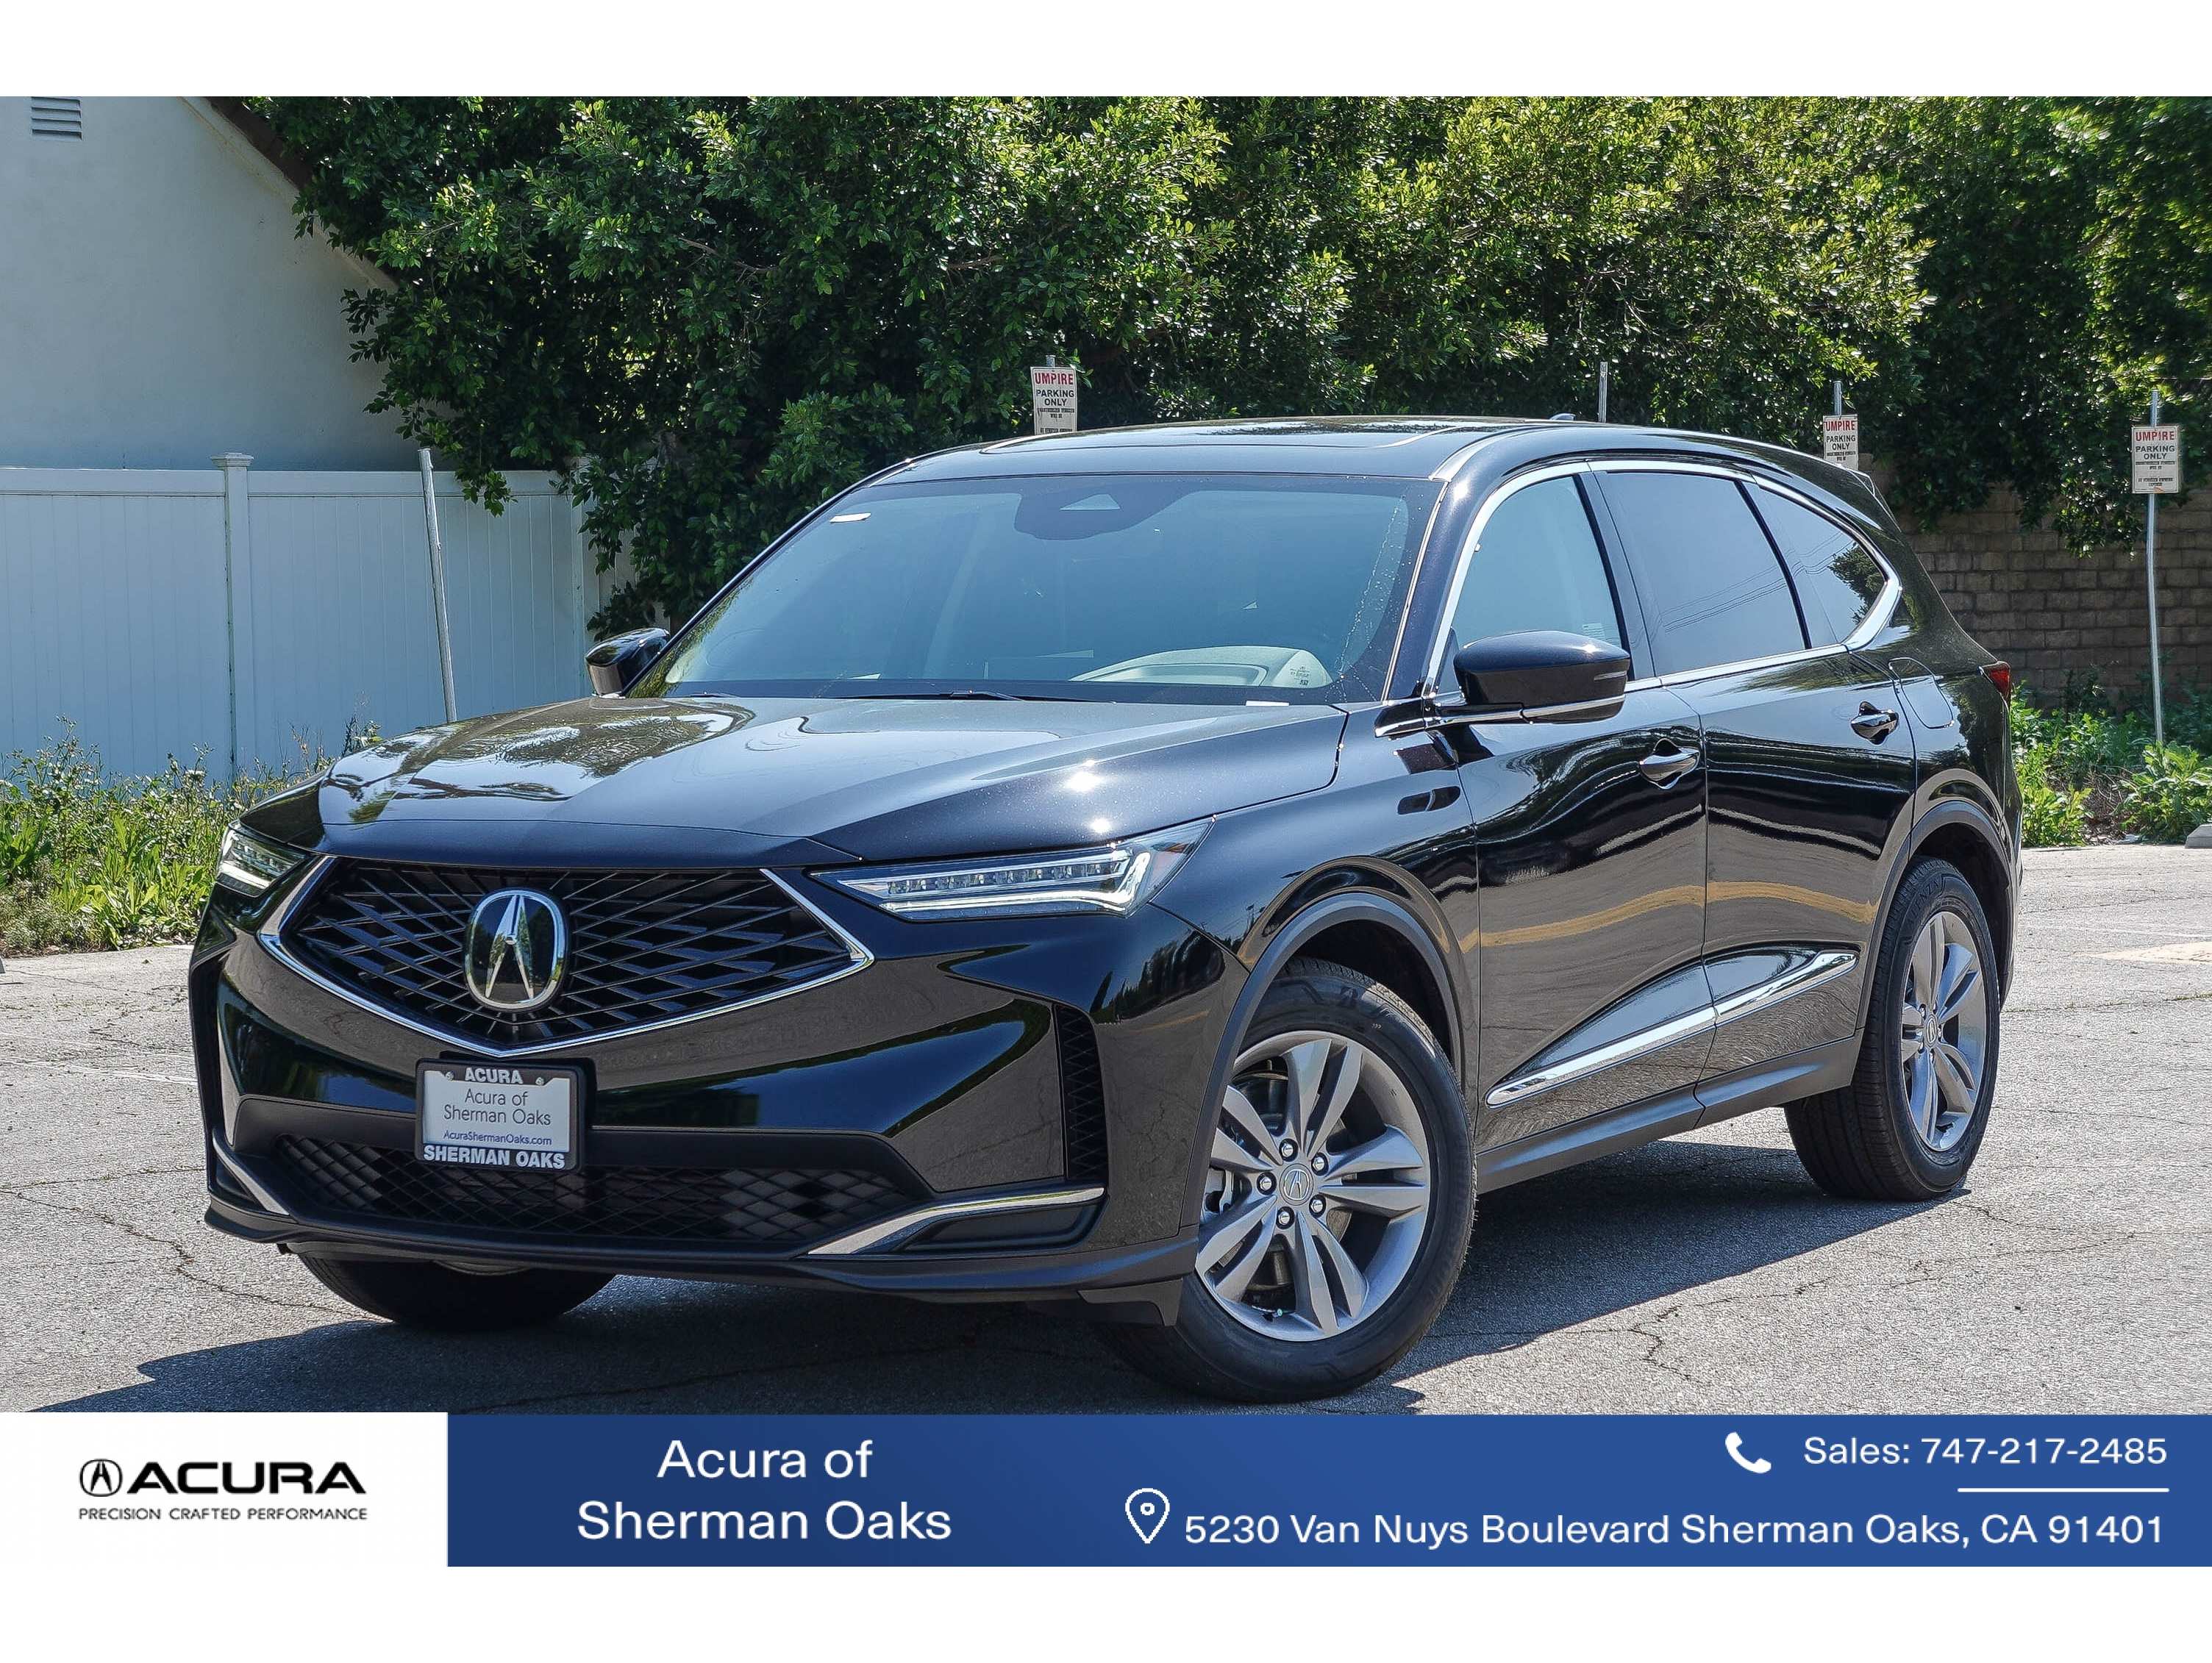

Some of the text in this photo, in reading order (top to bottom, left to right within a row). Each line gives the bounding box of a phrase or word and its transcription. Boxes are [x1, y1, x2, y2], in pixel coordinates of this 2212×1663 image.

[1035, 373, 1073, 385] UMPIRE
[1826, 421, 1855, 431] UMPIRE
[2136, 432, 2174, 441] UMPIRE
[465, 1067, 524, 1084] ACURA
[464, 1088, 528, 1106] Acura of
[443, 1104, 552, 1126] Sherman Oaks
[443, 1129, 552, 1145] AcuraShermanOaks.com
[424, 1145, 566, 1169] SHERMAN OAKS
